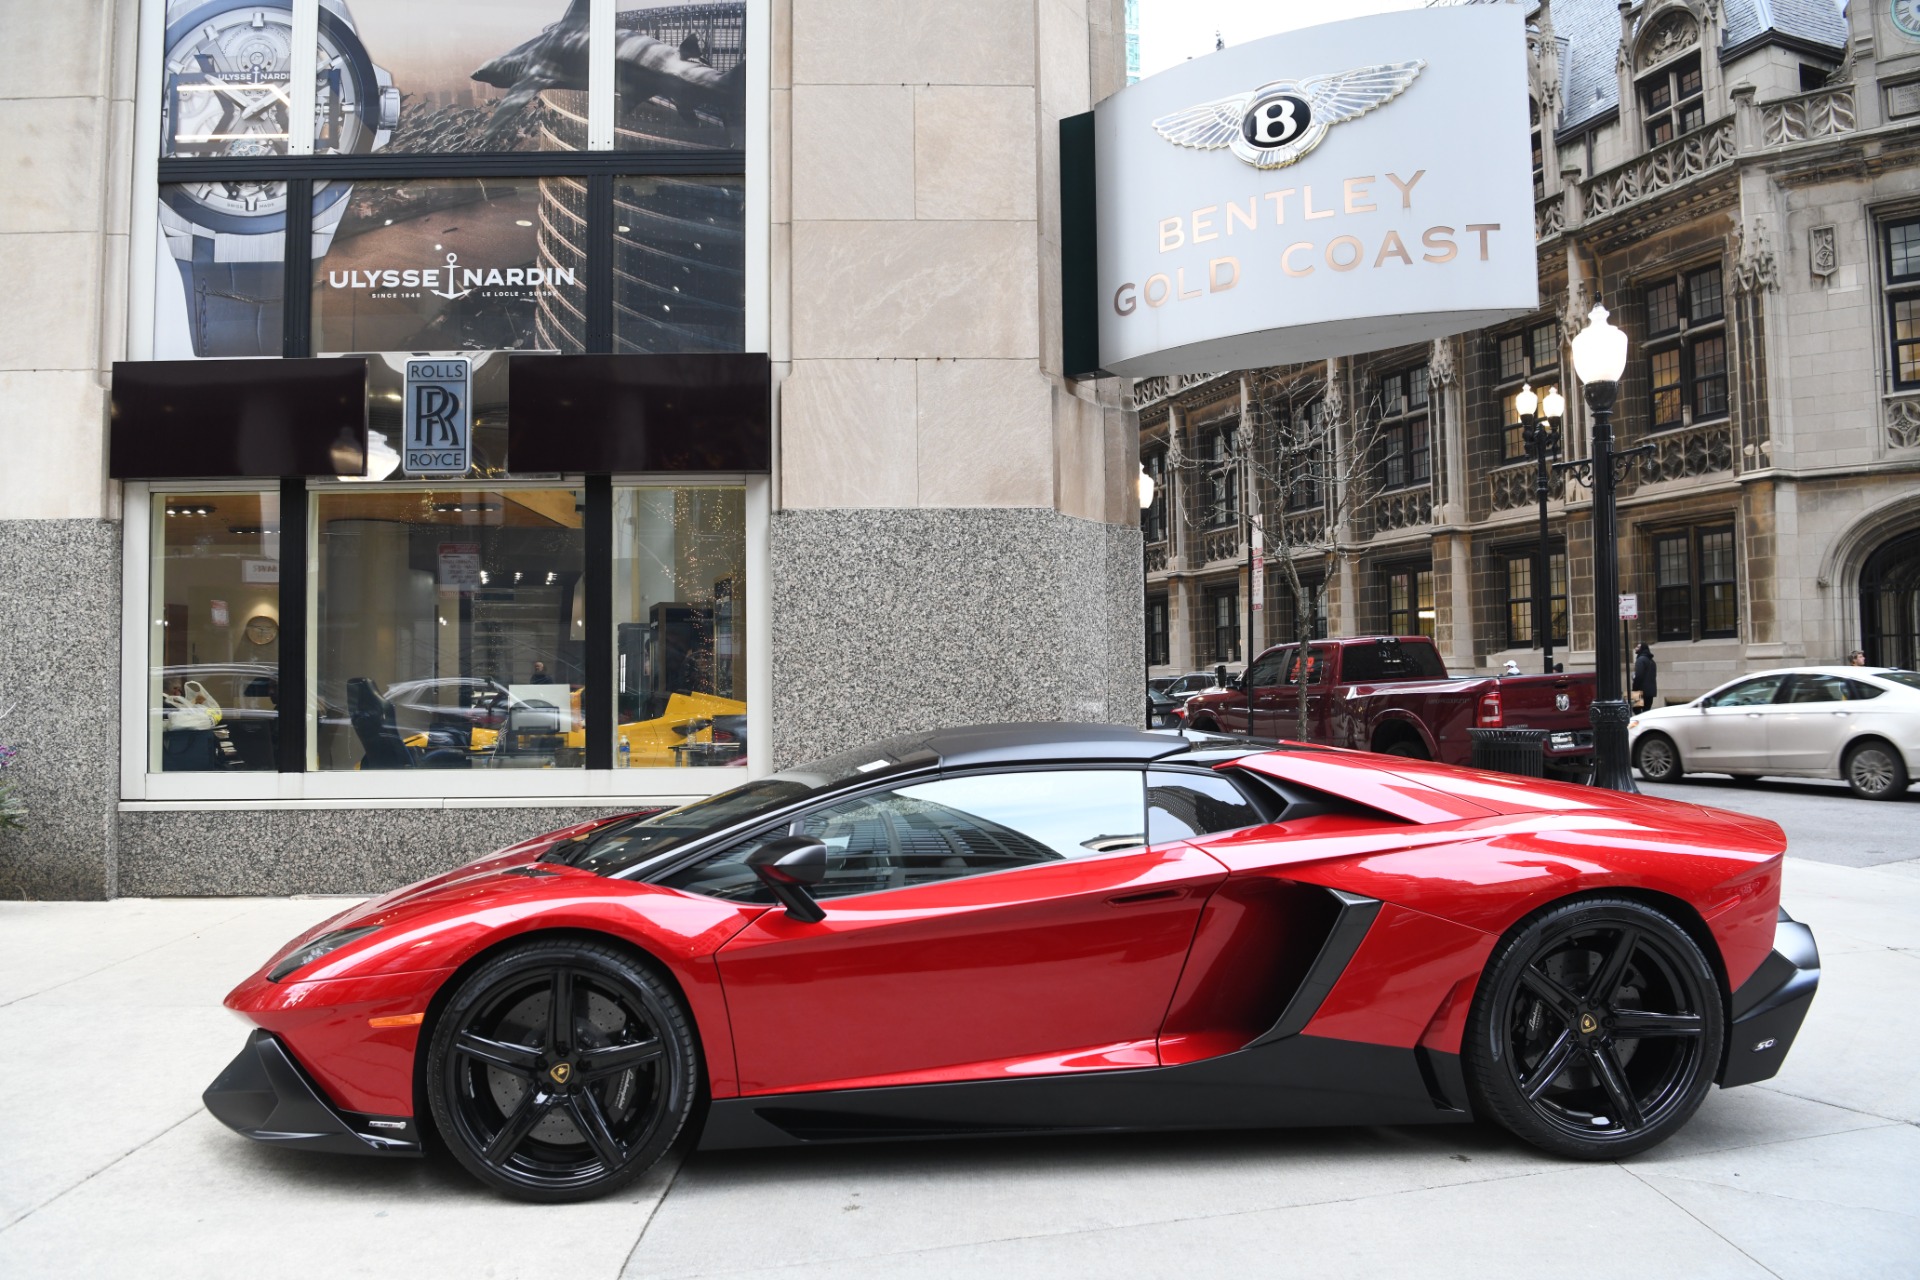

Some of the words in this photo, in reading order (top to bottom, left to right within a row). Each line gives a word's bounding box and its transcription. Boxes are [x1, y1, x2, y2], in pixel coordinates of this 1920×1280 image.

[218, 73, 252, 81] ULYSSE
[1254, 99, 1297, 144] B
[1159, 170, 1427, 254] BENTLEY
[329, 269, 440, 288] ULYSSE
[463, 267, 575, 287] NARDIN
[1113, 256, 1240, 316] GOLD
[1281, 223, 1501, 278] COAST
[411, 364, 463, 378] ROLLS
[414, 385, 460, 446] RR
[410, 453, 462, 467] ROYCE
